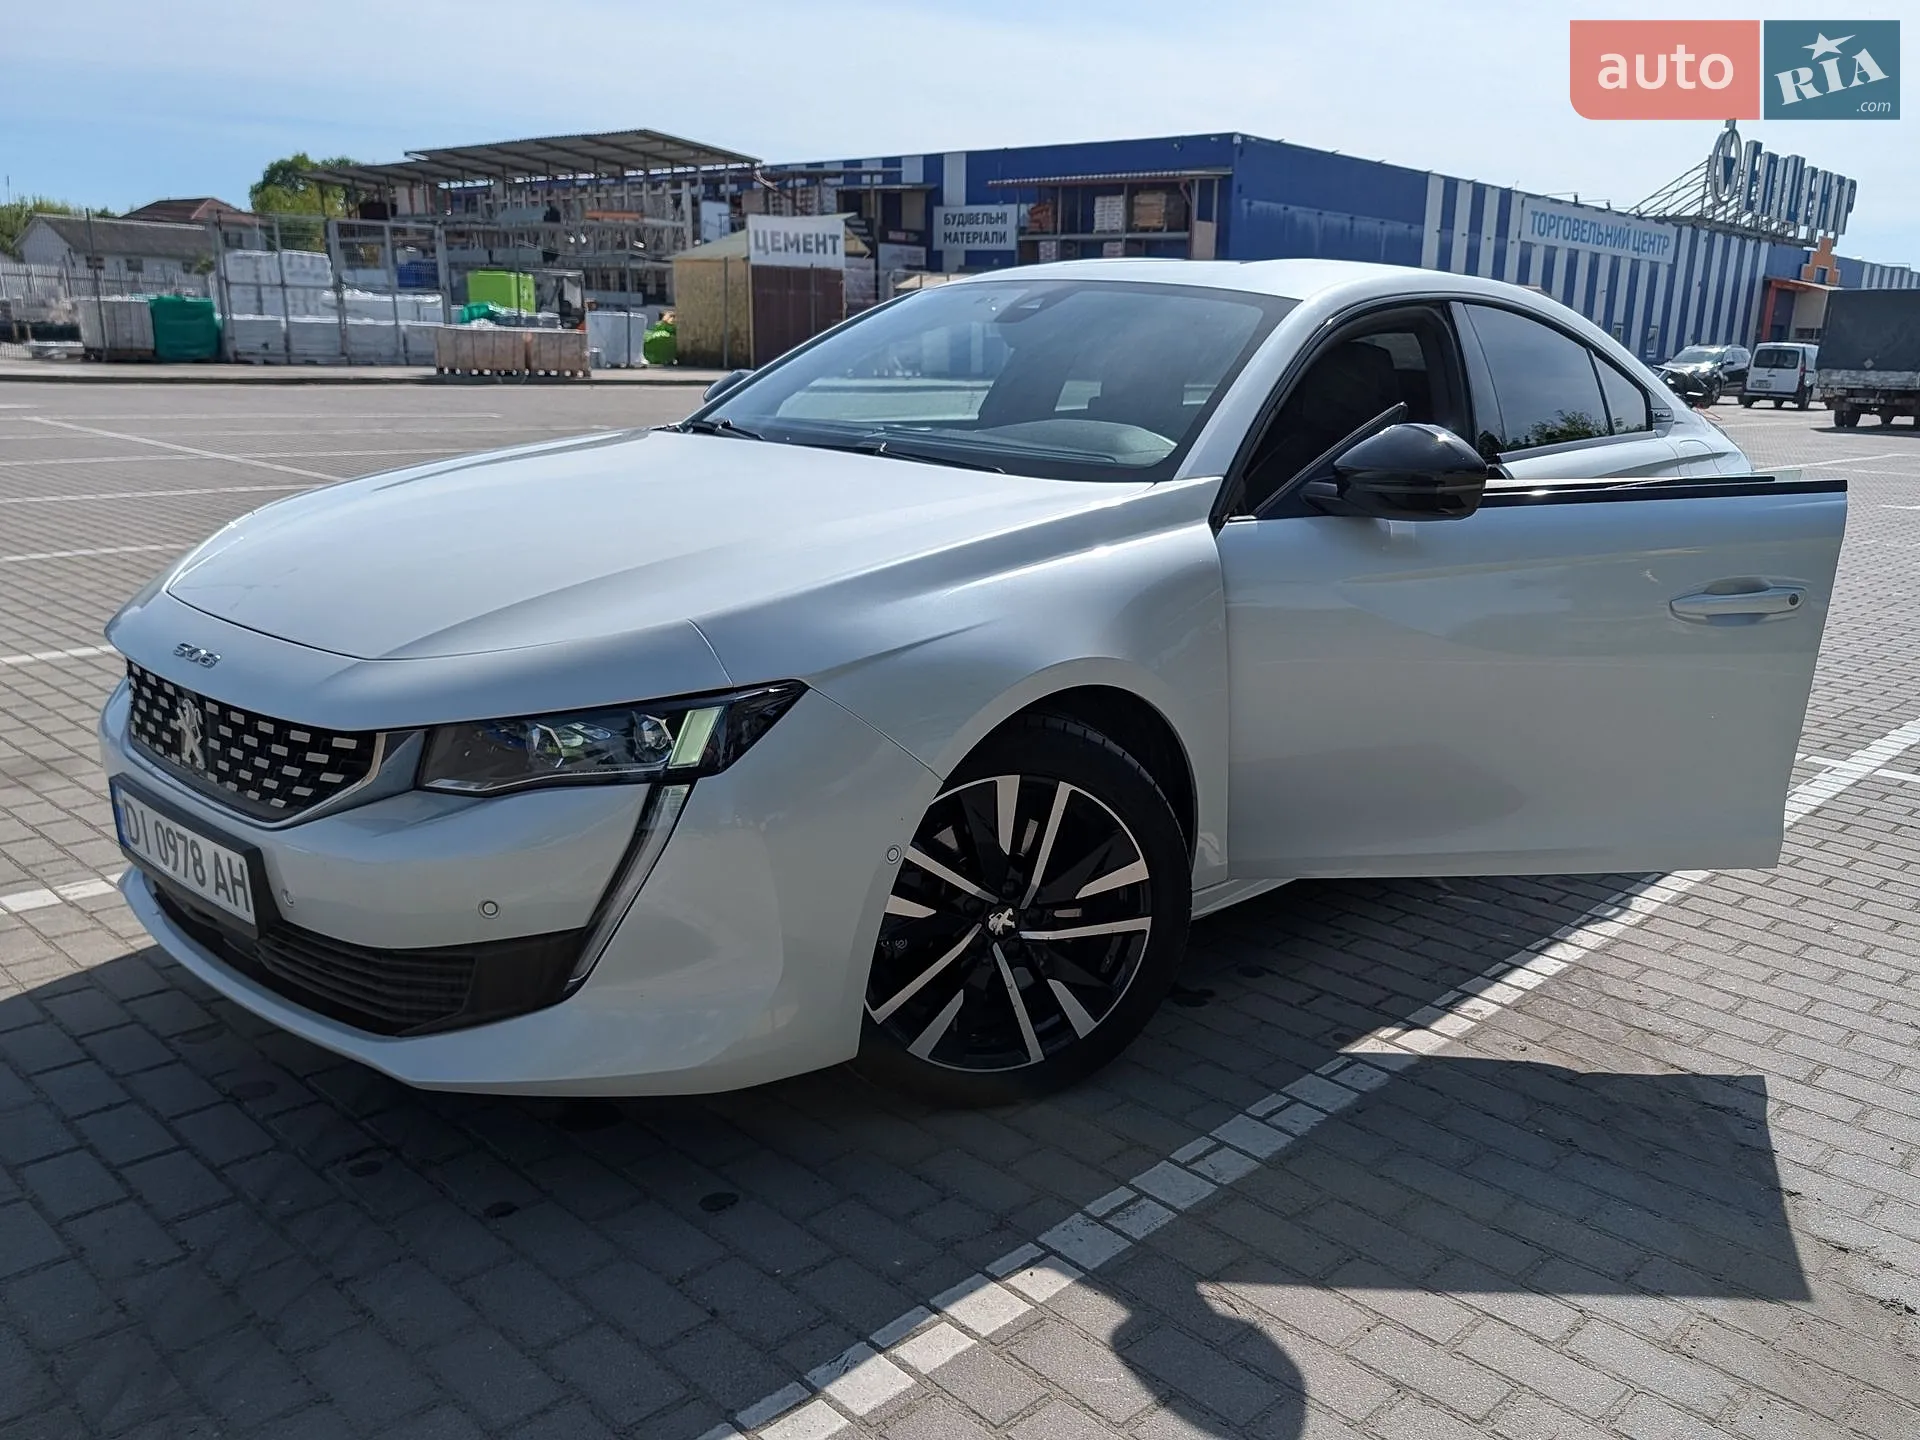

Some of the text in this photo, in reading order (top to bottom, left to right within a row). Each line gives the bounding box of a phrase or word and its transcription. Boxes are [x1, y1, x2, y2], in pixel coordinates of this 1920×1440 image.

[943, 211, 1008, 227] БУДІВЕЛЬНІ
[753, 229, 840, 256] ЦЕМЕНТ
[943, 230, 1008, 245] МАТЕРІАЛИ
[1530, 210, 1670, 256] ТОРГОВЕЛЬНИЙ ЦЕНТР
[173, 643, 221, 668] 508
[124, 799, 250, 913] DI 0978 AH
